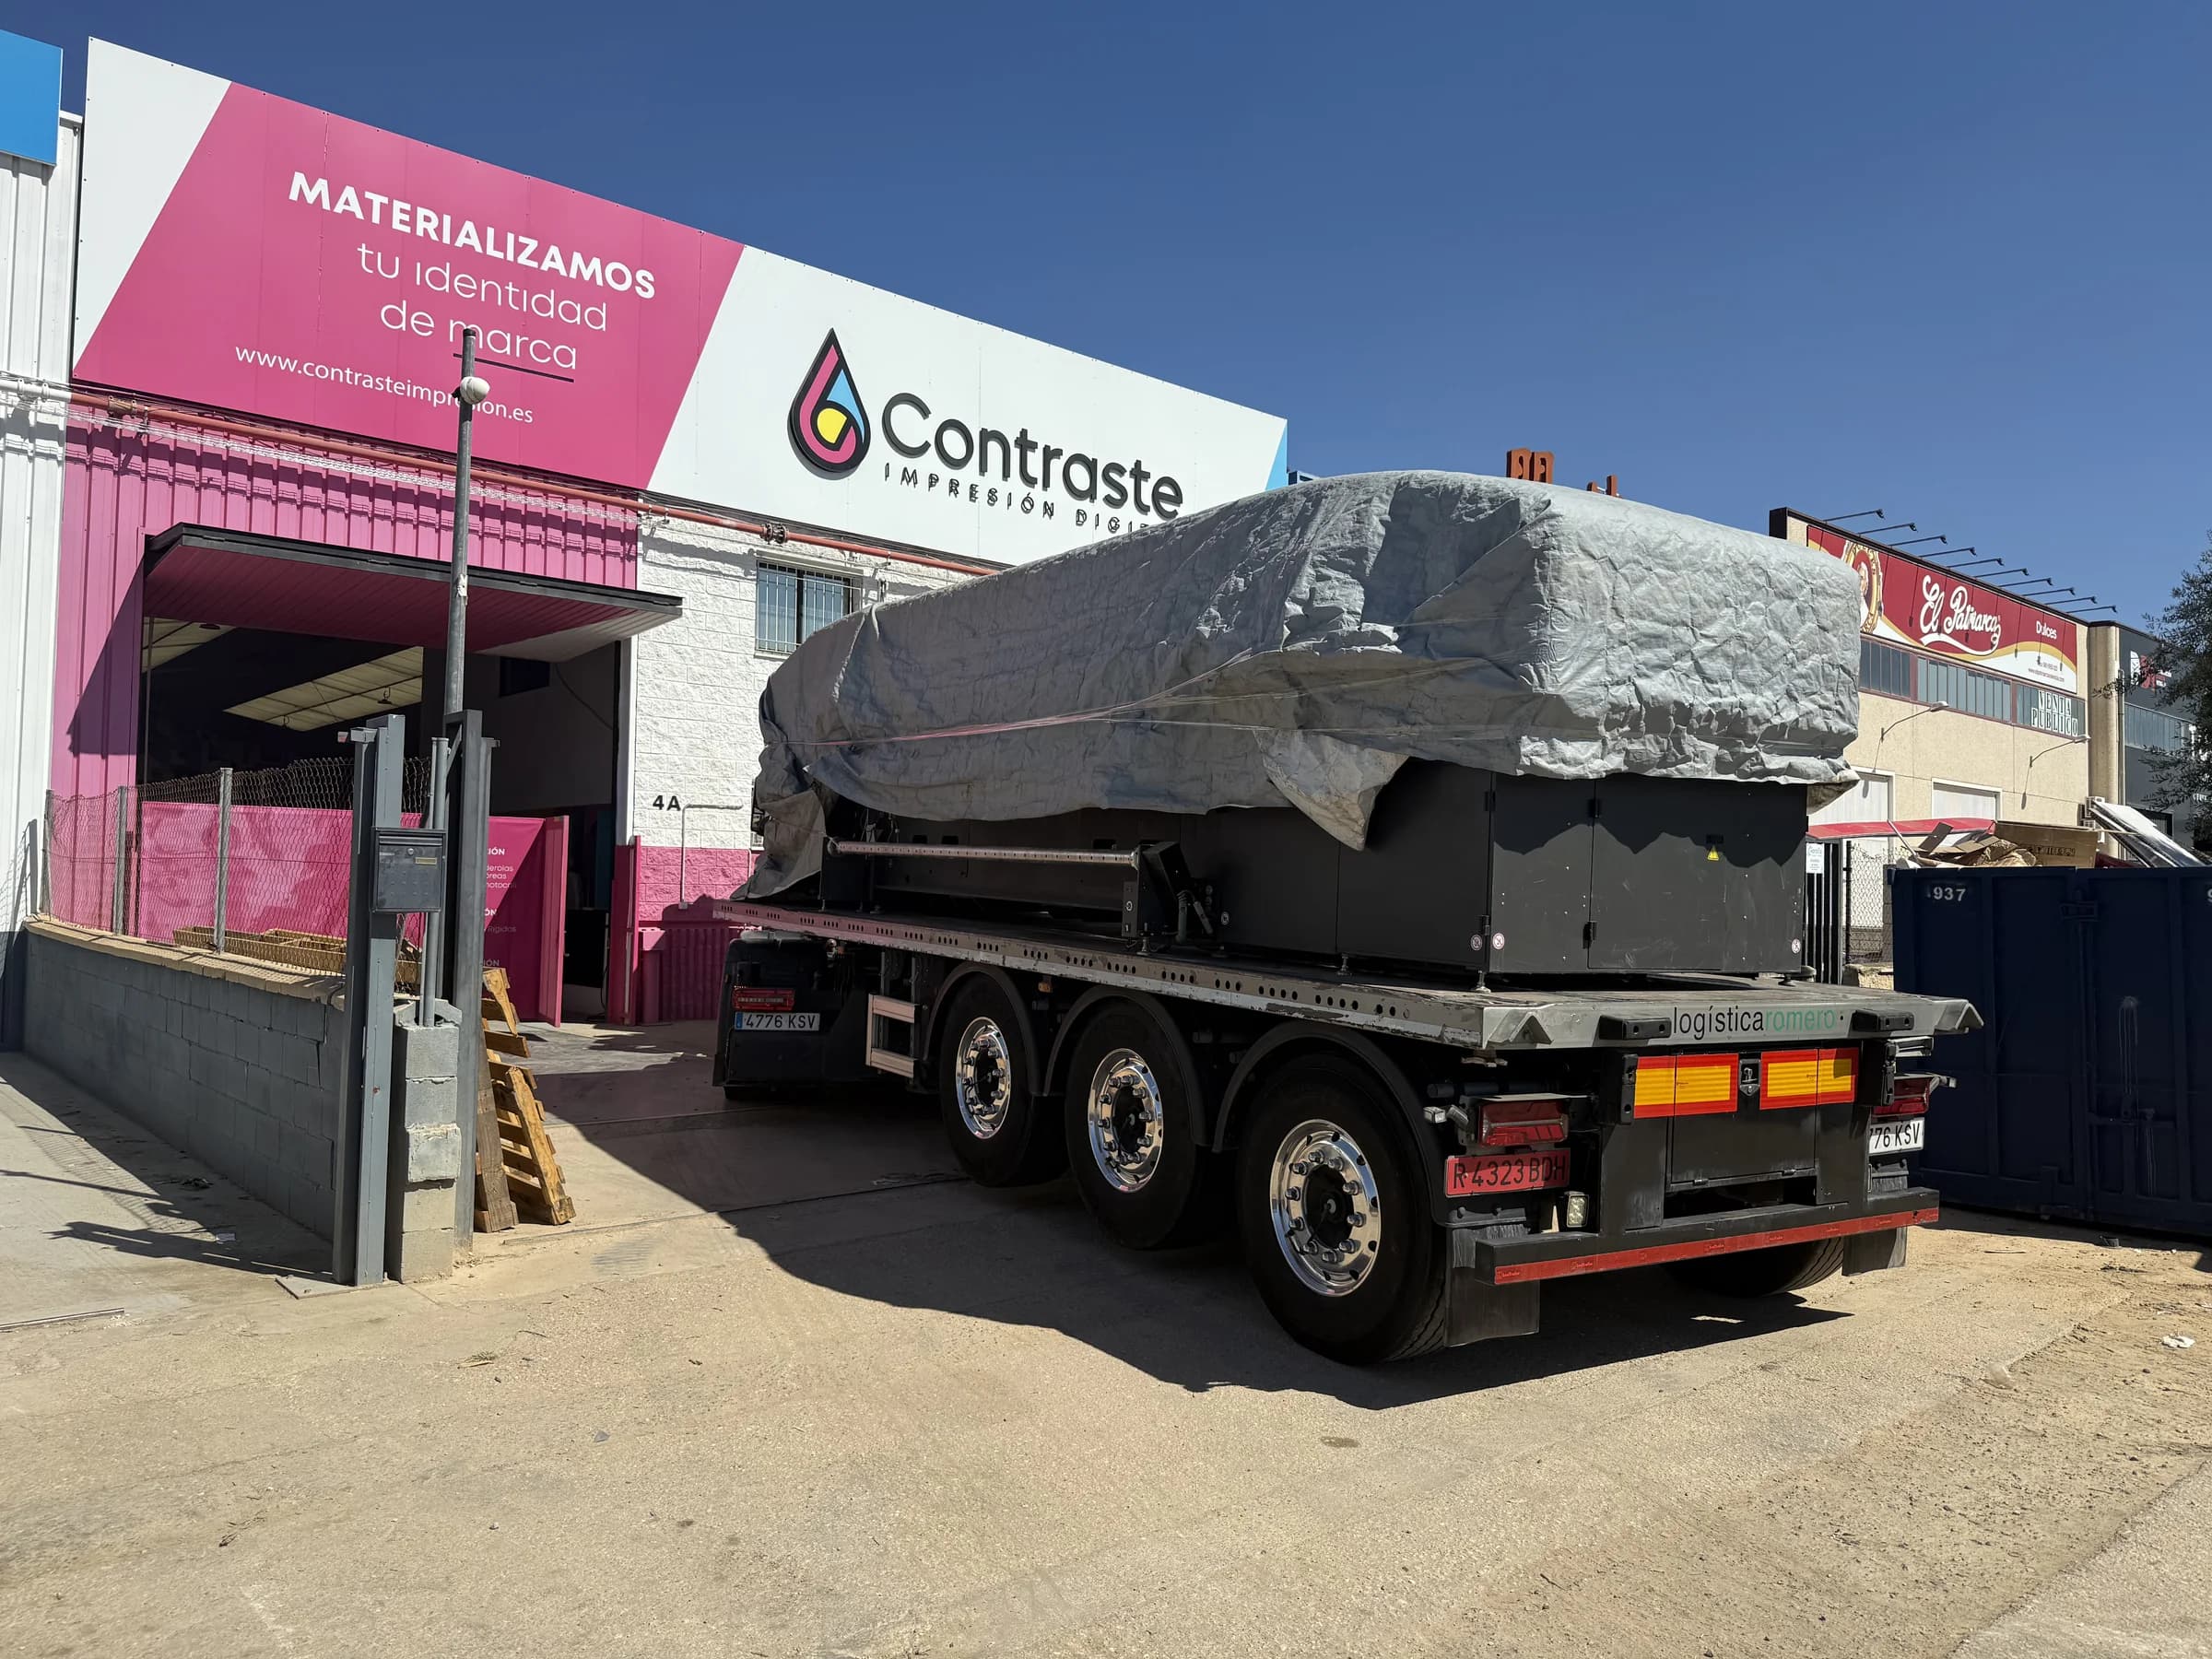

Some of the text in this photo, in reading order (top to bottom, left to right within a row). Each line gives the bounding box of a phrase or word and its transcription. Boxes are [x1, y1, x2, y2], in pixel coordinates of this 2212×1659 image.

[288, 171, 655, 300] MATERIALIZAMOS
[358, 243, 606, 332] tu identidad
[380, 300, 576, 370] de marca
[882, 393, 1183, 522] Contraste
[884, 462, 1054, 521] IMPRESIÓN
[1920, 575, 2001, 636] El Patriarca
[2035, 620, 2058, 640] Dulces
[2038, 690, 2072, 716] VENTA
[1933, 886, 1966, 901] 937
[746, 1014, 816, 1029] 4776 KSV
[1895, 1122, 1921, 1147] KSV
[1472, 1158, 1524, 1186] 4323
[1529, 1155, 1567, 1182] BDH
